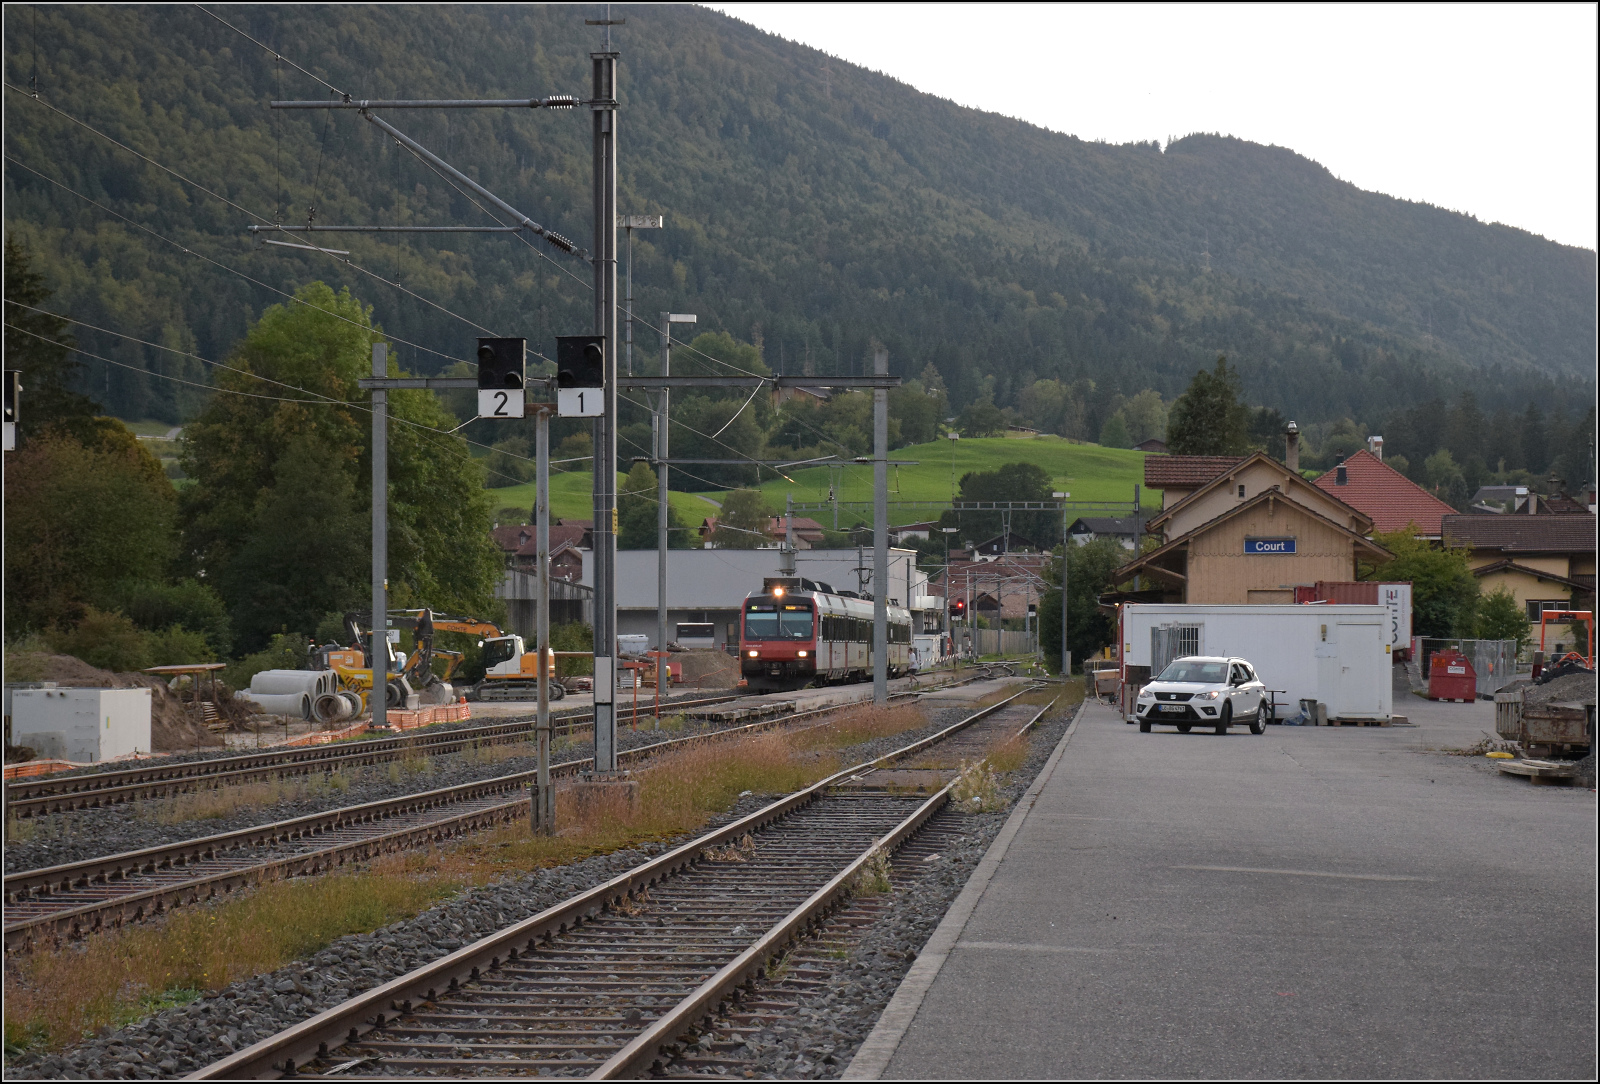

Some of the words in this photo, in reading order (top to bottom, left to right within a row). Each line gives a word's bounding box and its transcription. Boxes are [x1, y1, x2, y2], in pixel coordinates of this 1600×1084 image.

[494, 391, 508, 416] 2
[577, 391, 584, 413] 1
[1255, 541, 1285, 552] Court
